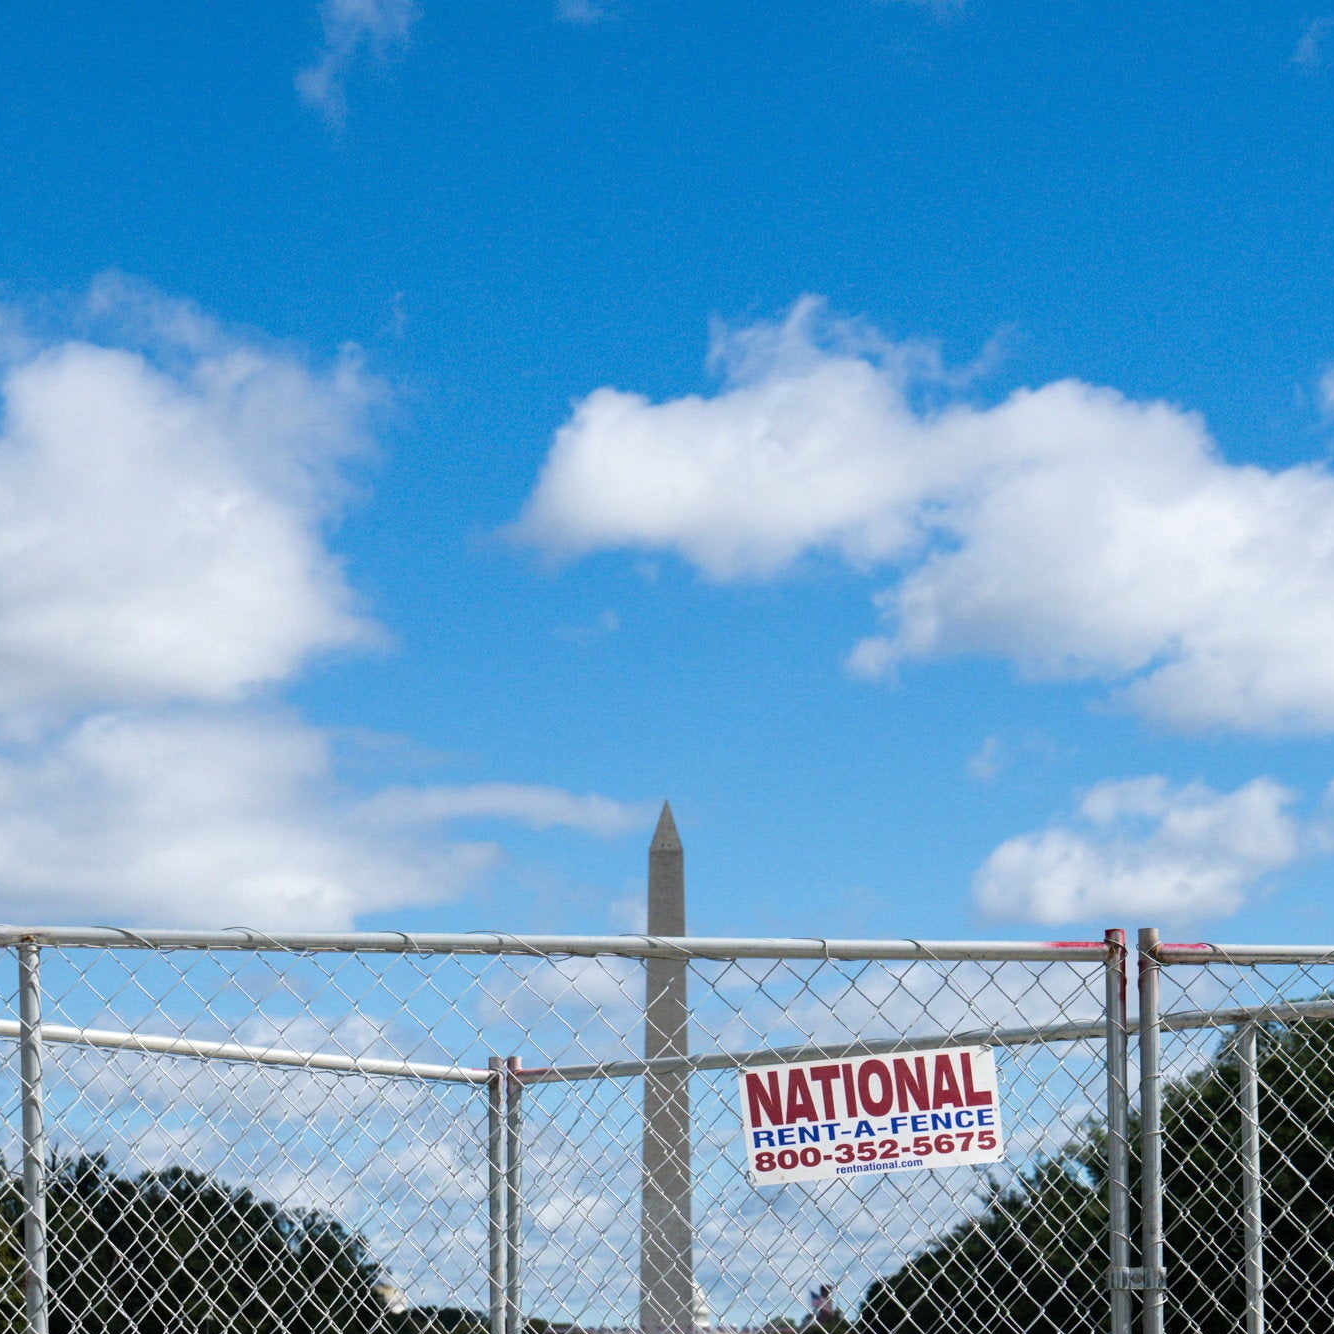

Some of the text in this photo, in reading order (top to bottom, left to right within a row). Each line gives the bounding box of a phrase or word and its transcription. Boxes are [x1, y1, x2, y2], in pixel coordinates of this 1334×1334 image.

[745, 1052, 993, 1128] NATIONAL
[753, 1108, 995, 1149] RENT-A-FENCE
[755, 1130, 997, 1172] 800-352-5675
[836, 1158, 923, 1175] rentnational.com
